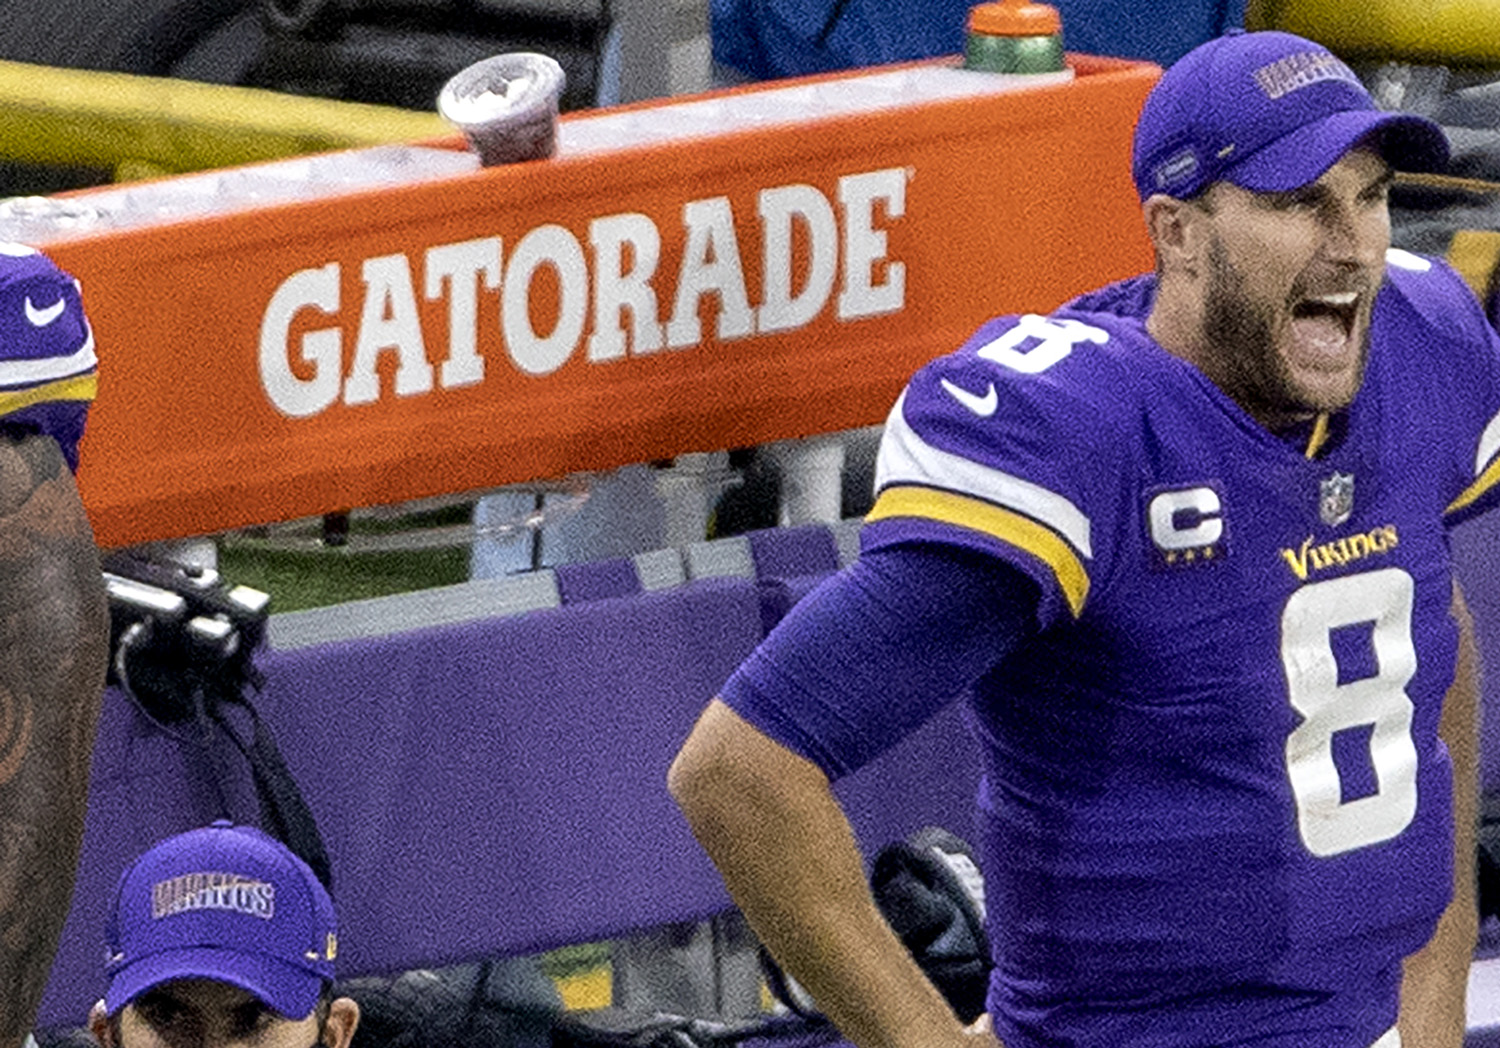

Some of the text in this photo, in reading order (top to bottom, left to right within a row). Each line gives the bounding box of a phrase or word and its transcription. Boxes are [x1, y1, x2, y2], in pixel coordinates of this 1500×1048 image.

[258, 167, 907, 418] GATORADE
[977, 313, 1110, 373] 8
[1150, 487, 1222, 549] C
[1281, 567, 1418, 858] 8
